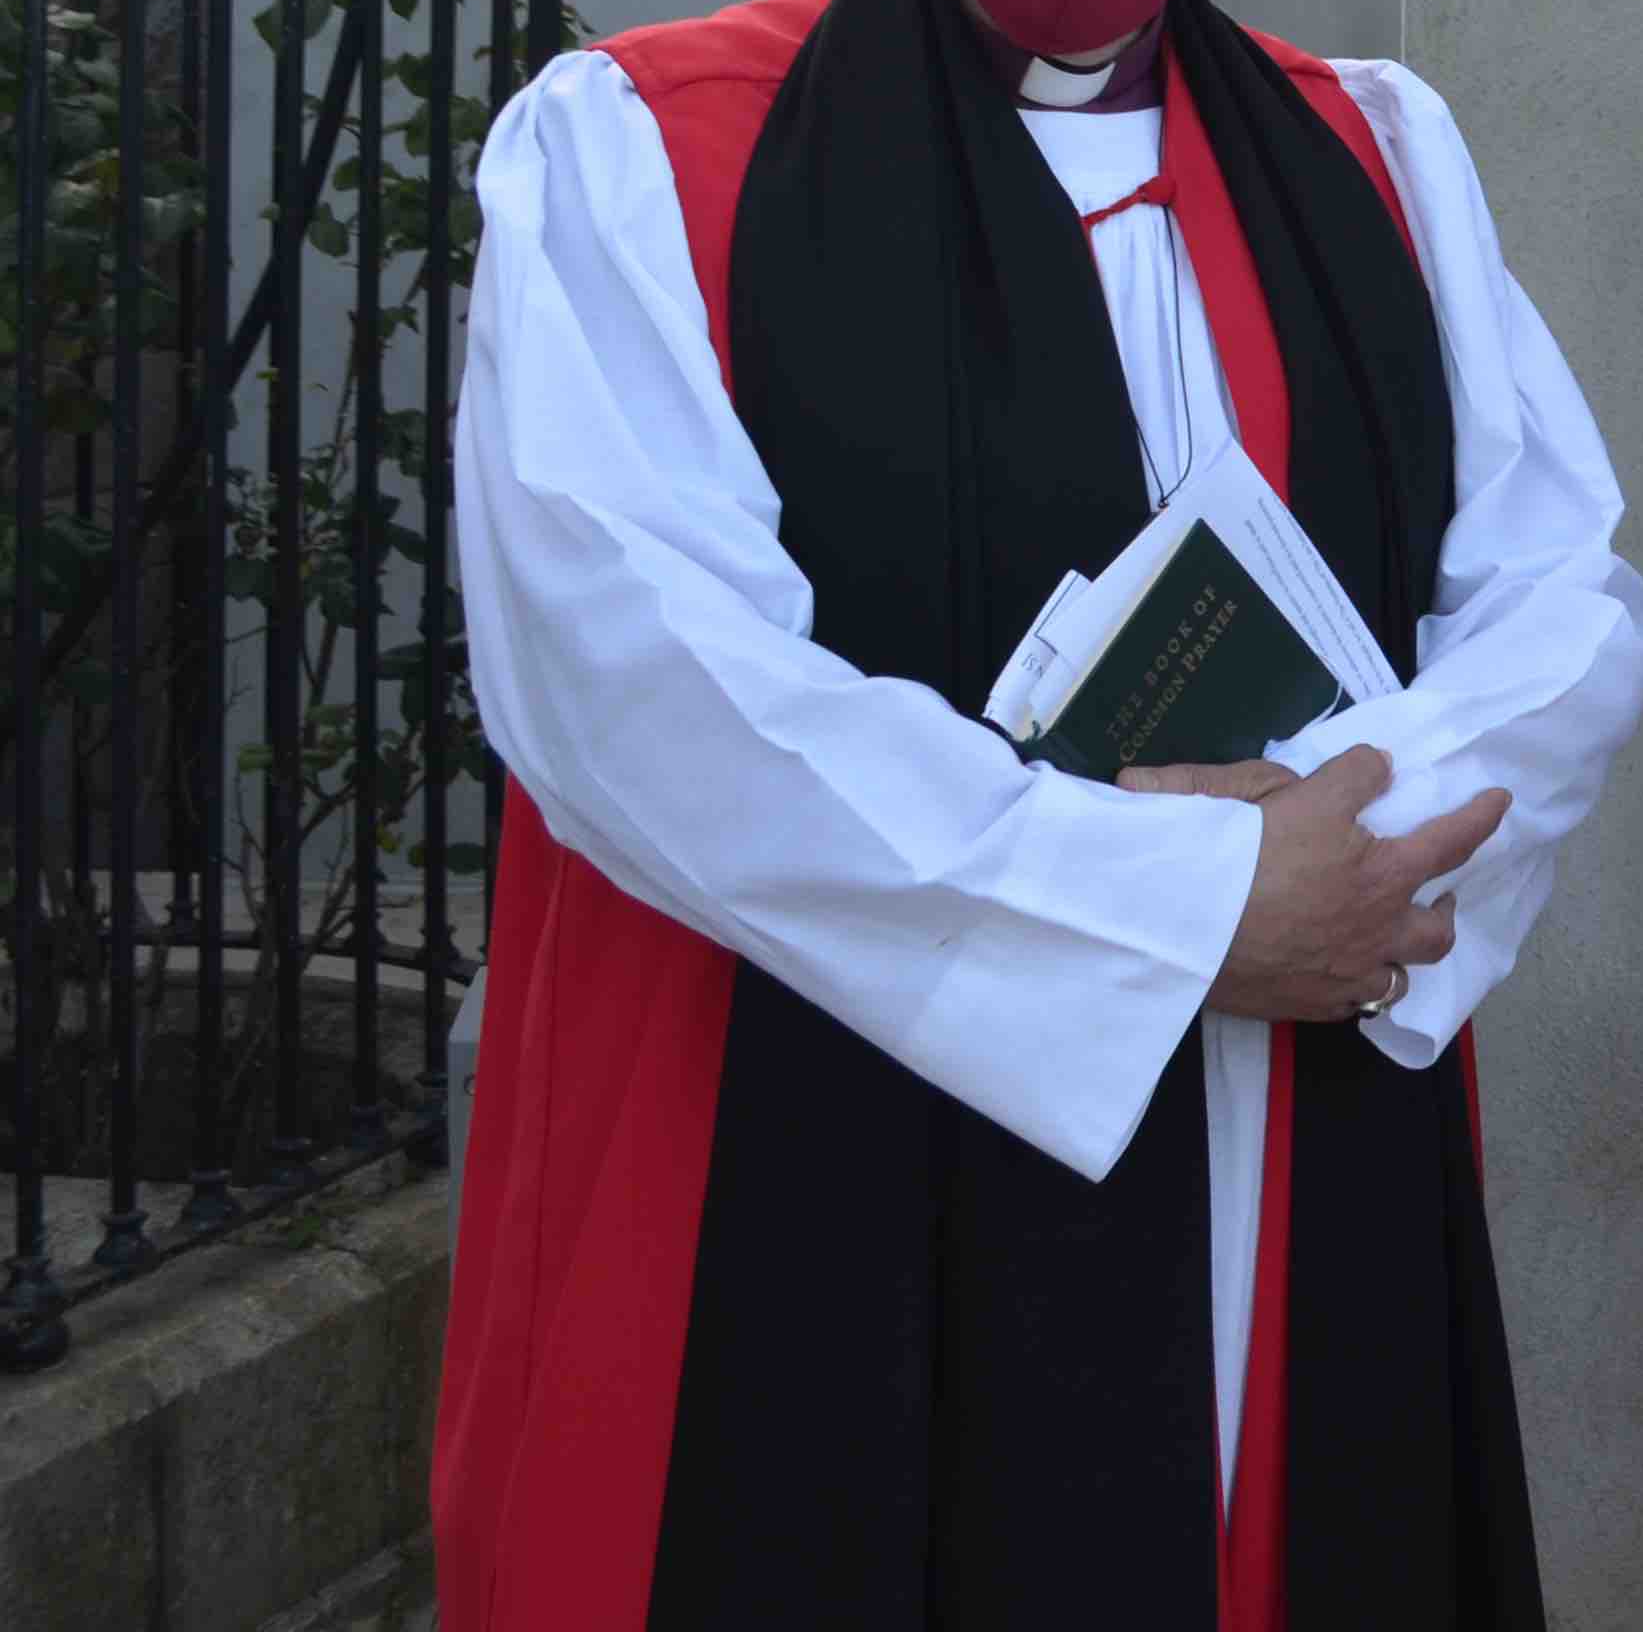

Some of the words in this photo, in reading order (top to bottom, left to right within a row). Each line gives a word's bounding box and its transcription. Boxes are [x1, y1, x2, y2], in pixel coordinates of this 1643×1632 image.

[1105, 692, 1143, 740] THE
[1144, 620, 1192, 686] BOOK
[1193, 584, 1216, 615] OF
[1120, 672, 1186, 761] COMMON
[1182, 599, 1238, 672] PRAYER
